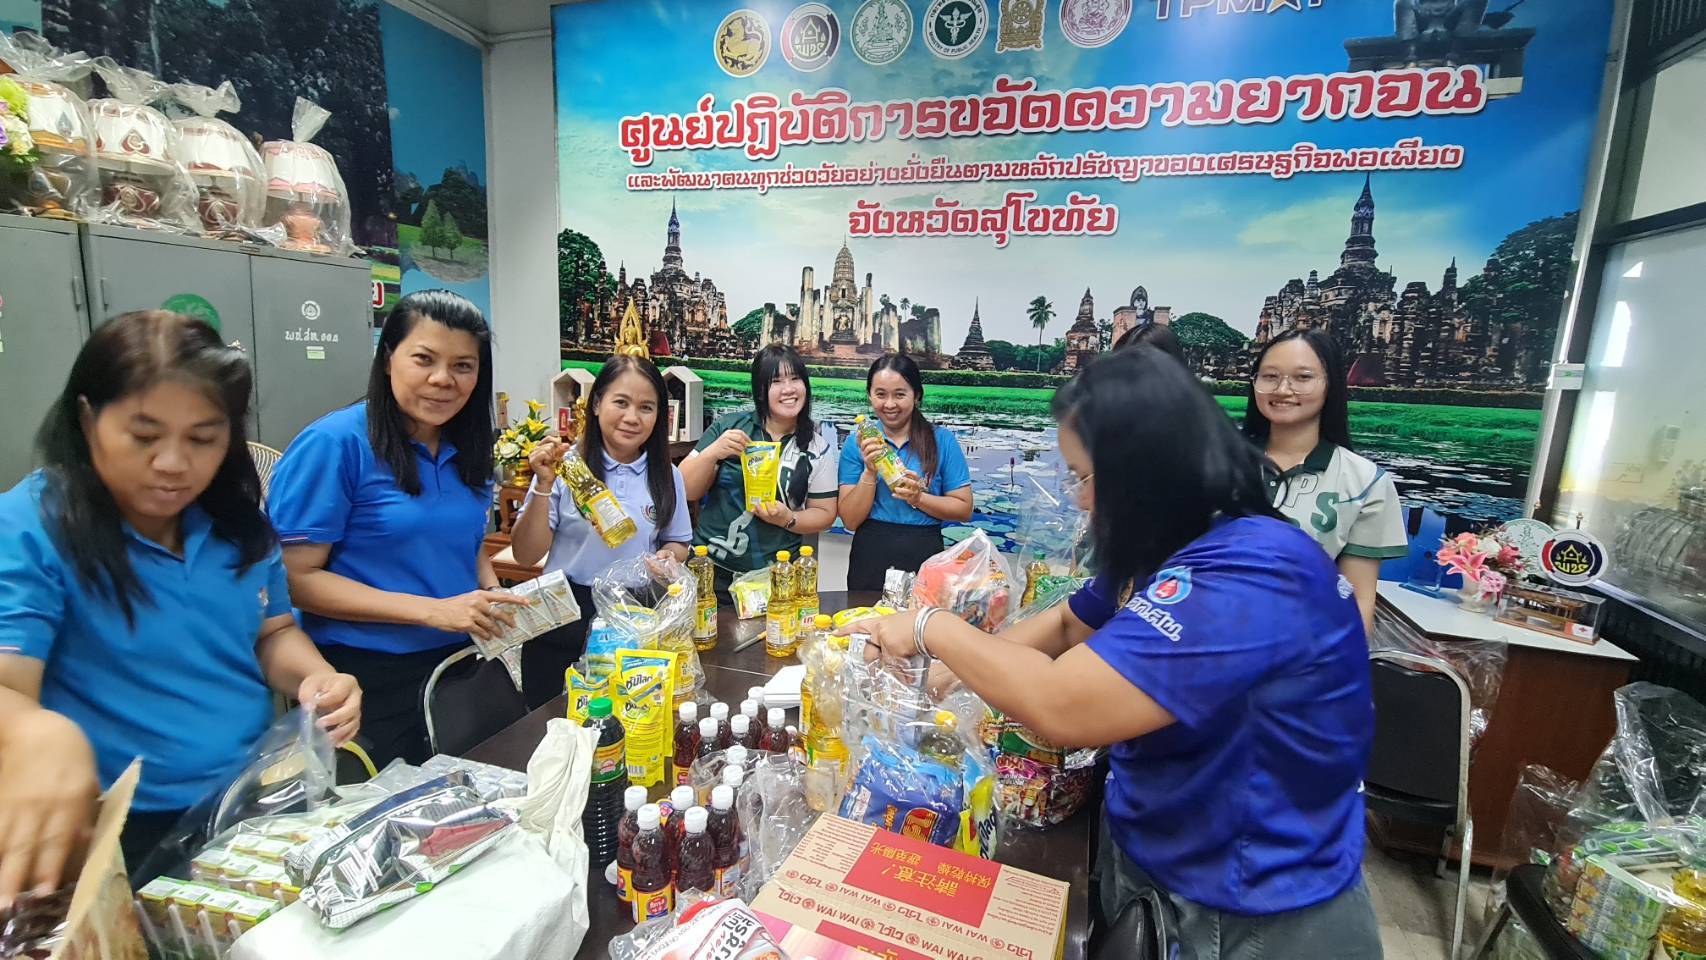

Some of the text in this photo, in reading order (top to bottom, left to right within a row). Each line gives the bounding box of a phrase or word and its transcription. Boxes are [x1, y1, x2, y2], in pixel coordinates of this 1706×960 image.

[620, 67, 1485, 164] ศูนย์ปฏิบัติการขจัดความยากจน
[627, 139, 1463, 194] และพัฒนาคนทุกช่วงวัยอย่างยั่งยืนตามหลักปรัชญาของเศรษฐกิจพอเพียง
[849, 192, 1119, 247] จังหวัดสุโขทัย
[839, 886, 858, 898] WAI
[861, 894, 881, 906] WAI
[816, 903, 837, 918] WAI
[839, 911, 860, 926] WAI
[921, 939, 944, 955] WAI
[942, 921, 962, 934] WAI
[966, 930, 988, 943] WAI
